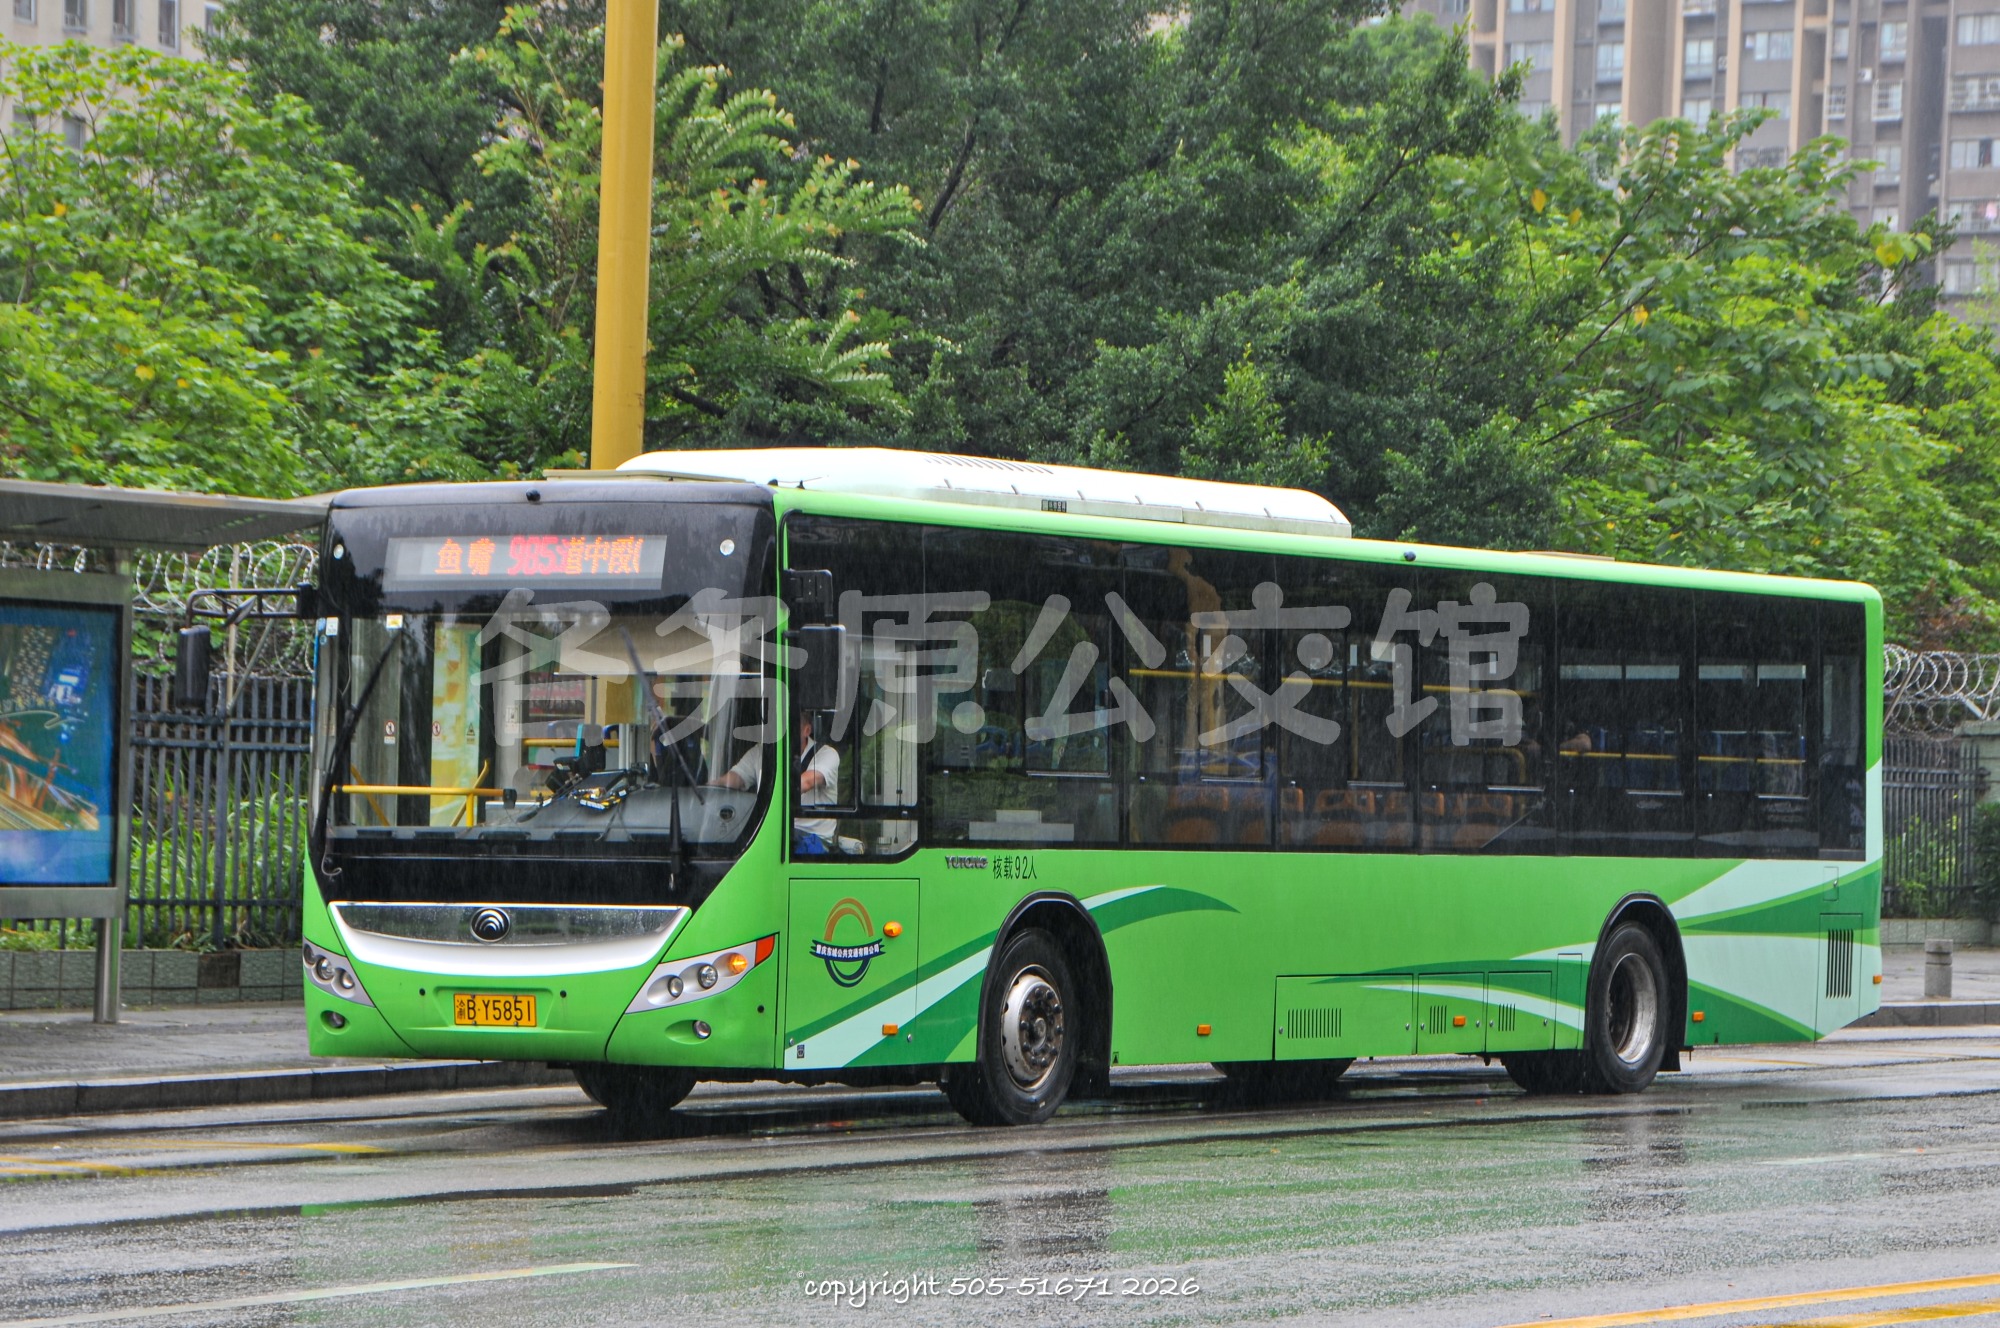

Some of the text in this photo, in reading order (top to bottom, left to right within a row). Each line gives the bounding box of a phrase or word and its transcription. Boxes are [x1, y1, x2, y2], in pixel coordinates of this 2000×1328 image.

[434, 537, 496, 576] 鱼嘴
[992, 854, 1037, 880] 核载92人
